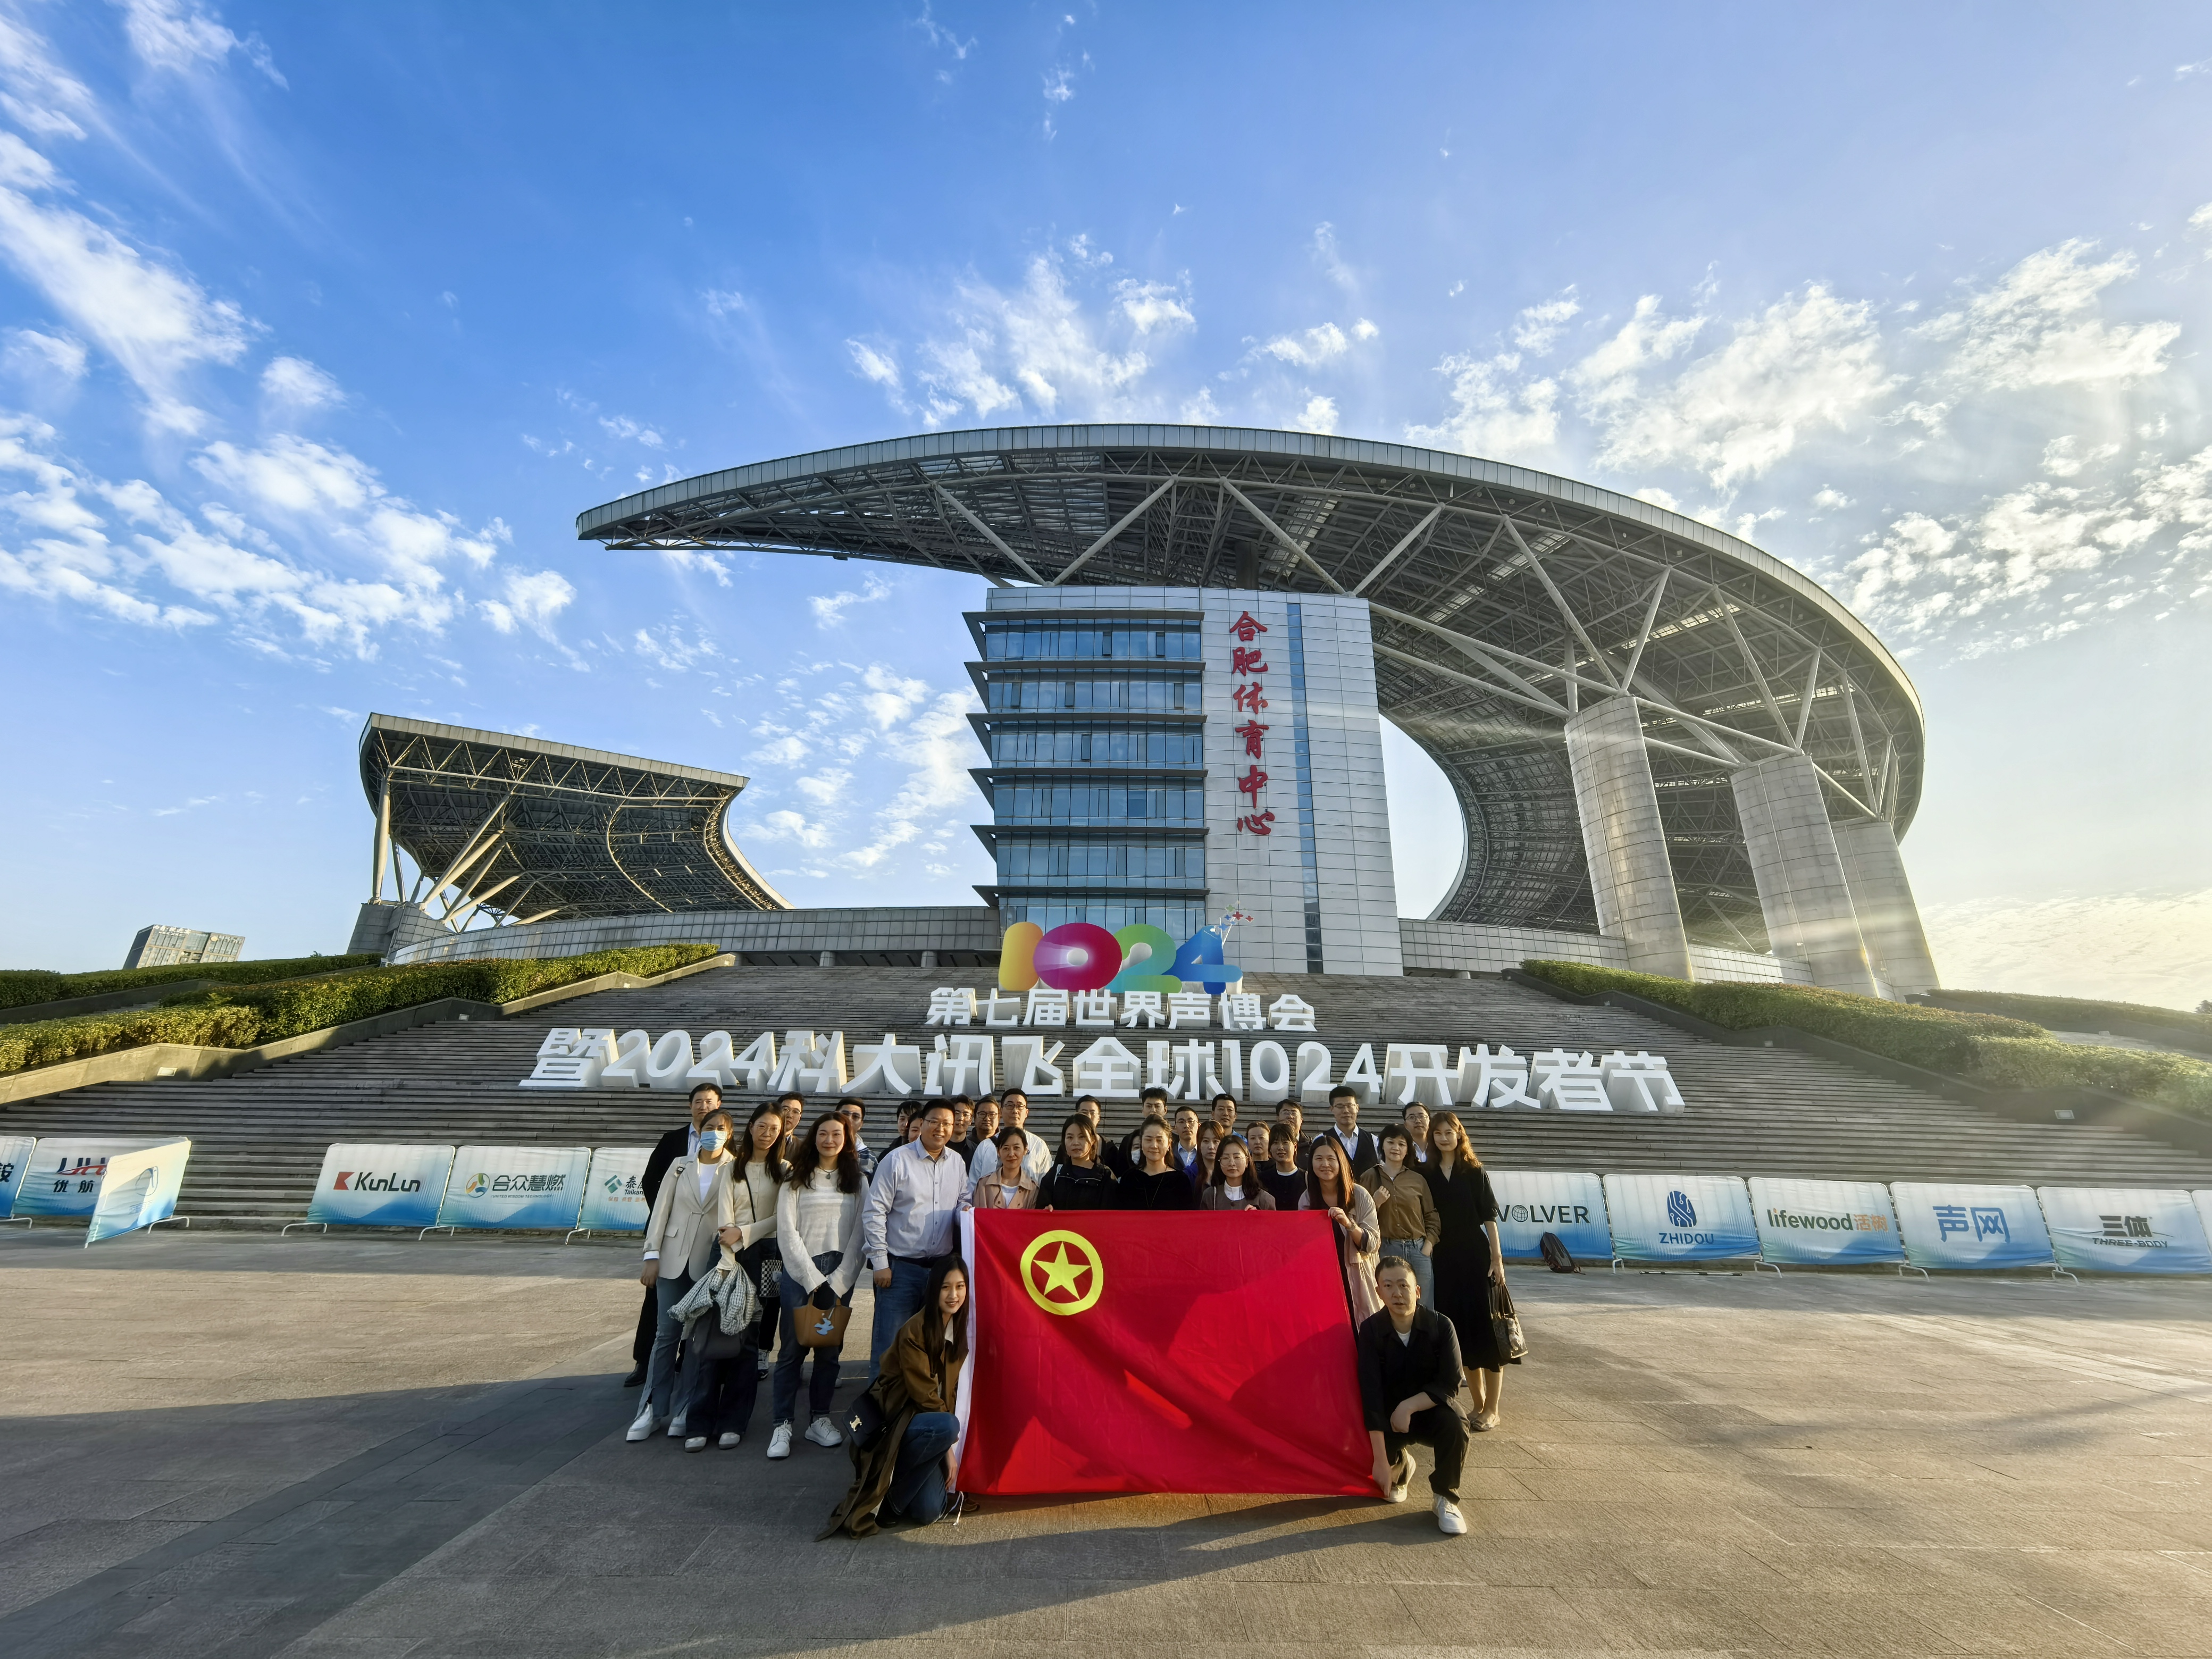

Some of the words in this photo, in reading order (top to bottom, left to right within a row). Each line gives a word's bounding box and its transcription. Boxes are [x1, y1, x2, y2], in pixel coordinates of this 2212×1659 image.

[1229, 610, 1275, 835] 合肥体育中心
[999, 921, 1243, 994] 1024
[926, 987, 1318, 1032] 第七届世界声博会
[492, 1174, 566, 1192] 合众慧燃
[625, 1175, 643, 1189] 泰
[1766, 1208, 1854, 1231] lifewood
[1933, 1204, 2010, 1244] 声网
[2098, 1215, 2152, 1237] 三体
[1659, 1233, 1714, 1245] ZHIDOU
[2092, 1237, 2168, 1249] THREE-BODY
